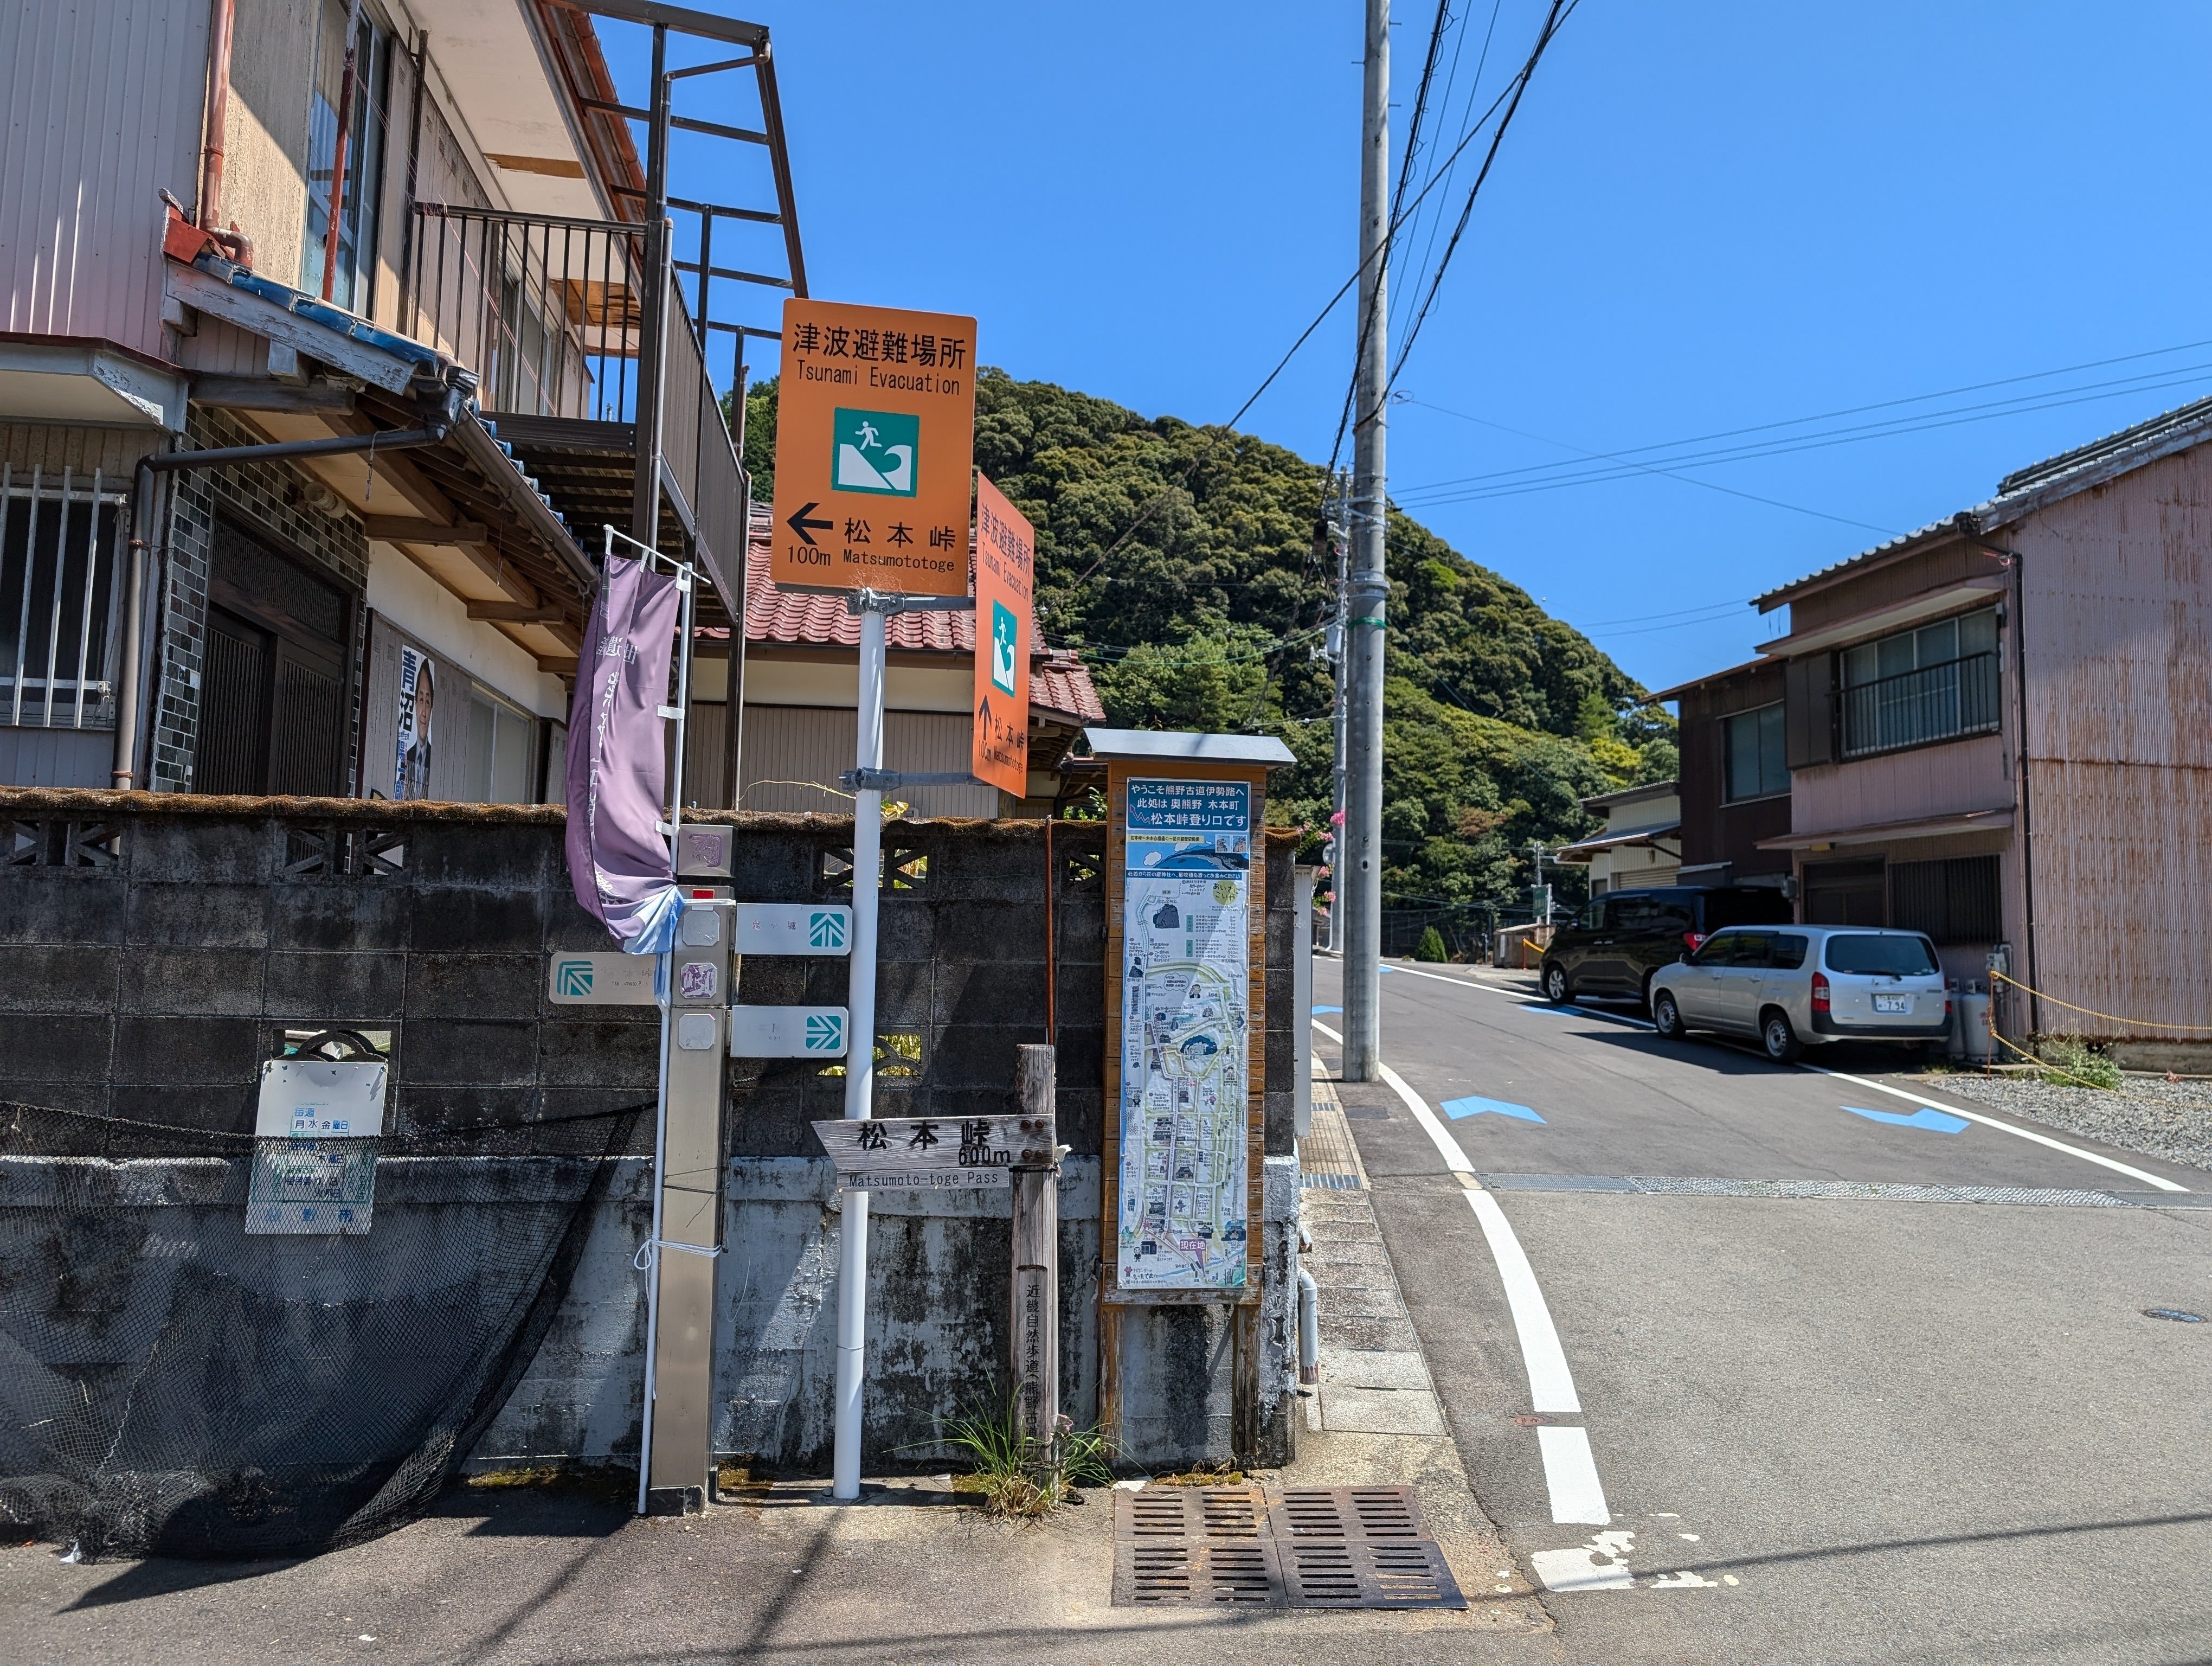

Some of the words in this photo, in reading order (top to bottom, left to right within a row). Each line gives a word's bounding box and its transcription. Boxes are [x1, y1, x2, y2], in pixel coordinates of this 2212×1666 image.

[793, 323, 966, 369] 津波避難場所
[797, 360, 859, 386] Tsunami
[870, 367, 960, 395] Evacuation
[844, 517, 956, 552] 松本峠
[981, 502, 1031, 577] 津波避難場所
[787, 546, 831, 566] 100m
[843, 549, 955, 573] Matsumototoge
[982, 541, 1001, 577] Tsunami
[1004, 561, 1029, 602] Evacuation
[398, 649, 417, 733] 青沼
[995, 713, 1024, 754] 松本峠
[979, 740, 991, 762] 100m
[994, 746, 1024, 774] Matsumototoge
[1131, 785, 1244, 797] やうこそ熊野古道伊勢路へ
[1171, 798, 1202, 809] 奥熊野
[1208, 800, 1239, 810] 木本町
[1151, 812, 1246, 826] 松本峠登り口です
[1213, 883, 1240, 894] あいさに
[1215, 892, 1236, 901] こいや
[857, 1118, 990, 1150] 松本峠
[958, 1146, 1011, 1165] 600m
[849, 1172, 959, 1188] Matsumoto-toge
[968, 1171, 998, 1183] Pass
[1180, 1240, 1205, 1250] 現在地
